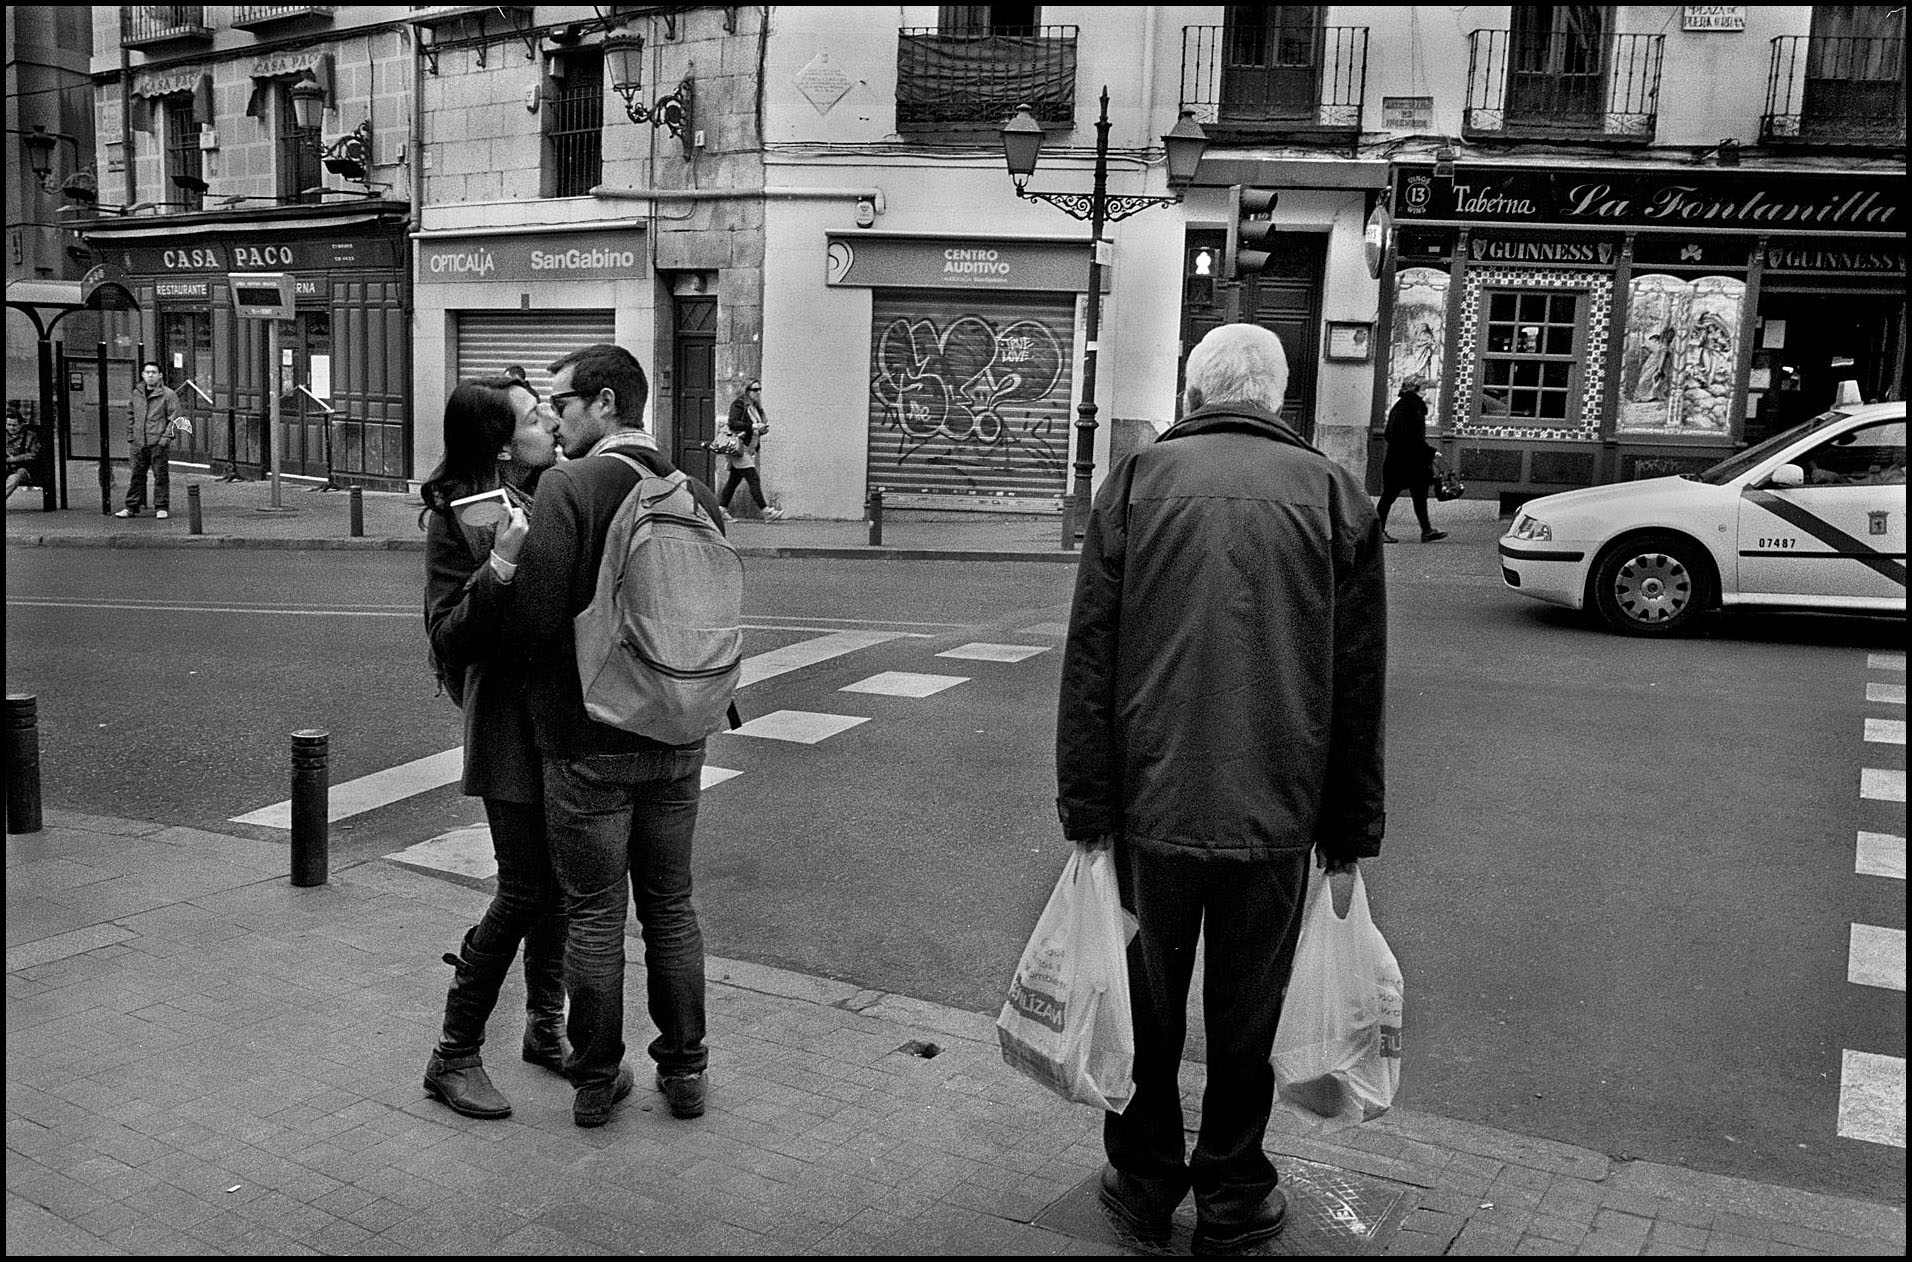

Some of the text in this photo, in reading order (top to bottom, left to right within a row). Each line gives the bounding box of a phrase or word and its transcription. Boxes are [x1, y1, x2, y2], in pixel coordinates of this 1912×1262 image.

[1411, 187, 1426, 203] 13
[1453, 183, 1897, 223] Taberna La Fontanilla
[944, 249, 999, 261] CENTRO
[1490, 234, 1594, 261] GUINNESS
[163, 246, 294, 268] CASA PACO
[531, 248, 634, 270] SanGabino
[1786, 250, 1894, 270] GUINNESS
[943, 261, 1010, 274] AUDITIVO
[156, 284, 208, 295] RESTAURANTE
[1001, 350, 1033, 362] LOVE
[1759, 538, 1796, 548] 07487
